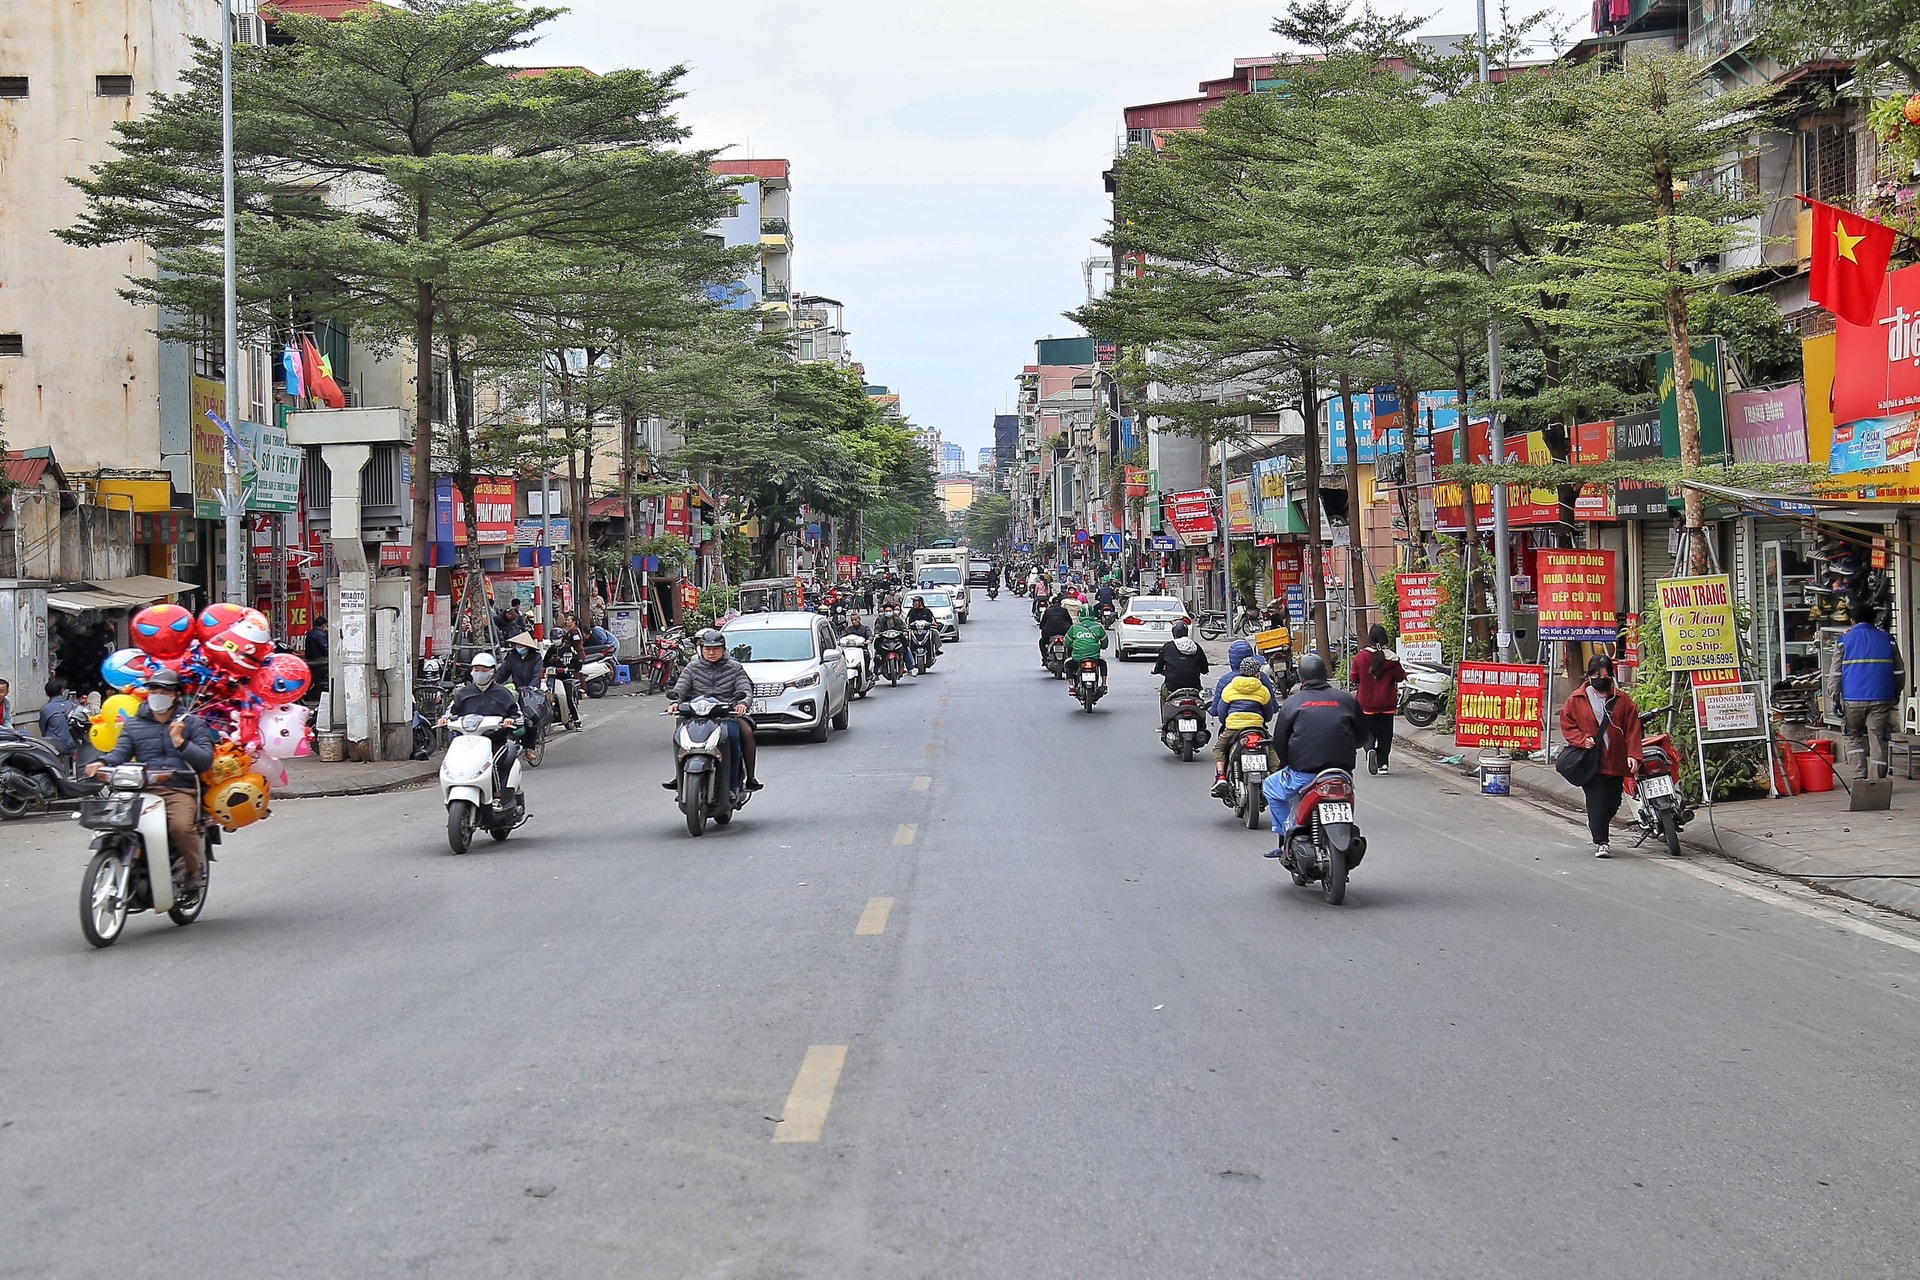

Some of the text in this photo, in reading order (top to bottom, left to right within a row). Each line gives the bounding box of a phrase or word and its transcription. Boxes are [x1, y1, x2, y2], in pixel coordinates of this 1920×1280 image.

[1627, 422, 1651, 448] AUDIO
[262, 447, 271, 471] SỐ
[476, 497, 492, 523] PHÁT
[492, 503, 512, 523] MOTOR
[1547, 552, 1605, 566] THANH ĐỒNG
[1543, 572, 1607, 585] MUA BÁN GIÀY
[1571, 591, 1585, 603] CŨ
[1586, 592, 1602, 604] XỊN
[1662, 580, 1728, 609] BÁNH TRÁNG
[290, 608, 308, 625] XE
[1540, 610, 1557, 621] DÂY
[1591, 610, 1601, 621] VÍ
[1669, 612, 1685, 626] Cô
[1701, 628, 1720, 638] 2D1
[1680, 641, 1723, 652] có Ship:
[1687, 653, 1734, 666] 094.549.5995
[1461, 668, 1540, 687] KHÁCH MUA BÁNH TRÁNG
[1461, 689, 1539, 720] KHÔNG ĐỖ XE
[1459, 722, 1539, 738] TRƯỚC CỬA HÀNG
